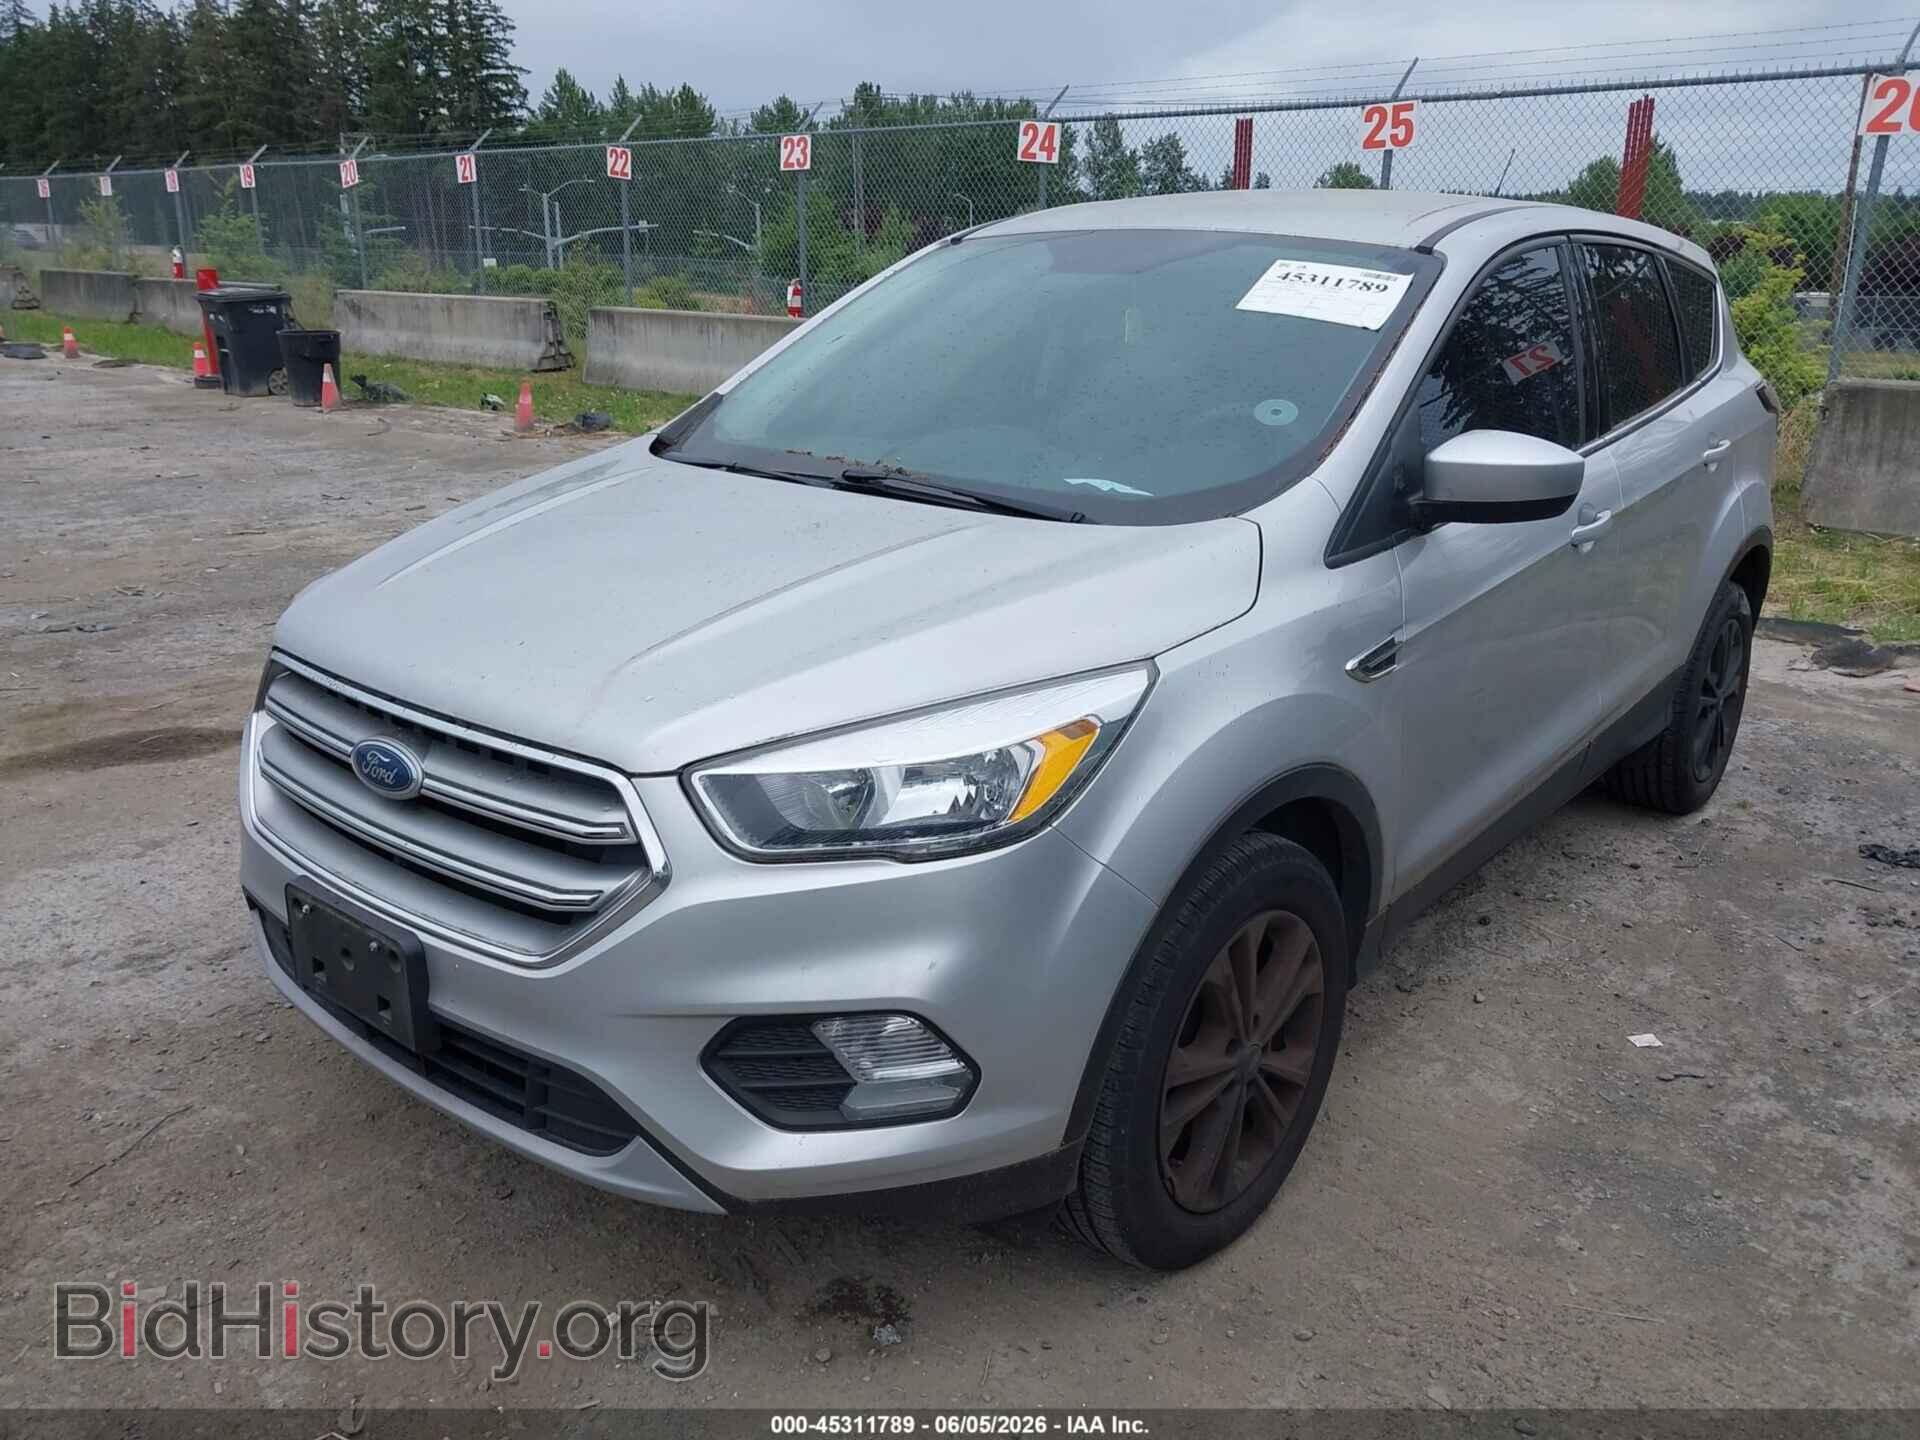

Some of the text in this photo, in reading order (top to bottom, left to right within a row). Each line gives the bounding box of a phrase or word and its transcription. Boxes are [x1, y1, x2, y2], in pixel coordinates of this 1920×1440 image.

[1866, 79, 1920, 133] 2
[1020, 122, 1056, 161] 24
[1362, 103, 1415, 150] 25
[459, 156, 474, 181] 21
[609, 148, 630, 178] 22
[783, 137, 808, 170] 23
[242, 166, 254, 186] 19
[343, 163, 357, 187] 20
[1277, 271, 1389, 294] 45311789
[361, 750, 398, 785] Ford
